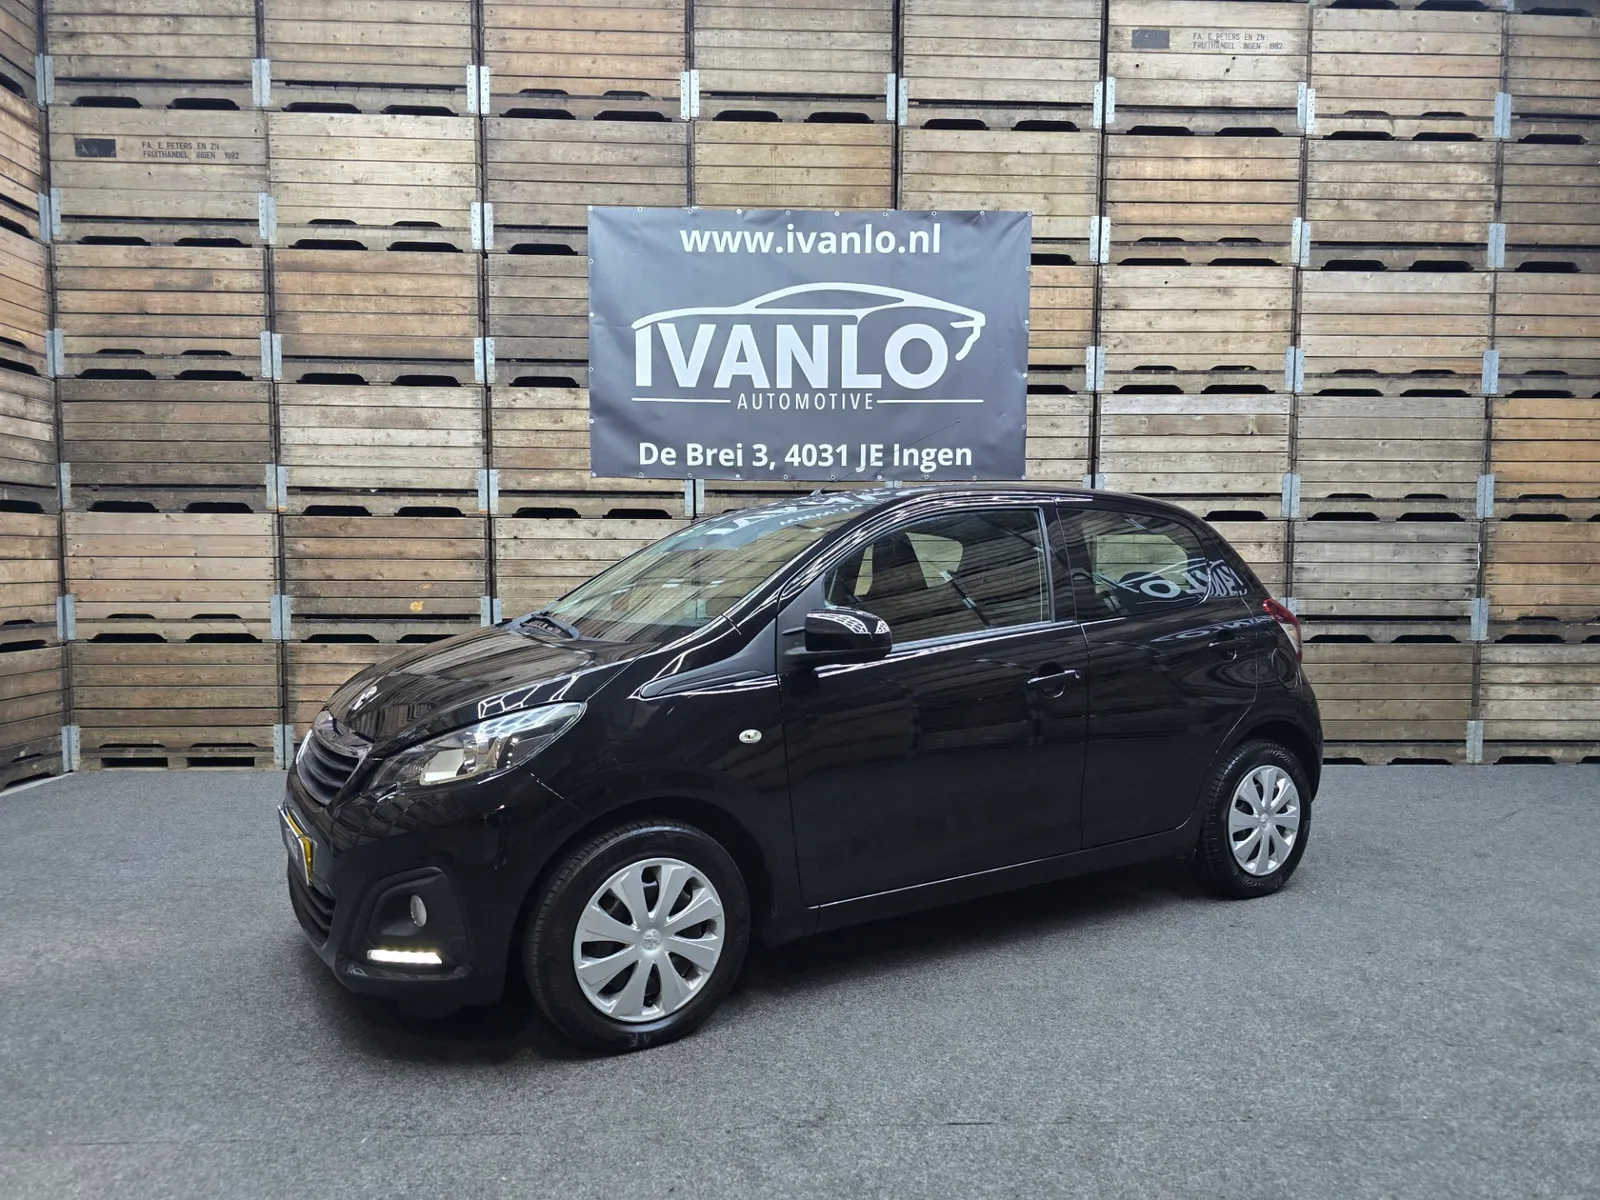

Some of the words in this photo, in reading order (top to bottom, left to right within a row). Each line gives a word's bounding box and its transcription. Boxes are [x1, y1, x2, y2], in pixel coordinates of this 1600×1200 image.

[1216, 33, 1240, 41] PETERS
[1244, 33, 1253, 41] EN
[1242, 42, 1261, 50] INGEN
[167, 142, 193, 150] PETERS
[196, 142, 207, 150] EN
[143, 150, 188, 158] FRUITHANDEL
[195, 151, 216, 159] INGEN
[680, 223, 941, 254] www.ivanlo.nl
[634, 322, 949, 390] IVANLO
[737, 393, 875, 411] AUTOMOTIVE
[639, 442, 677, 466] De
[686, 442, 744, 467] Brei
[752, 444, 776, 471] 3,
[784, 444, 849, 467] 4031
[856, 444, 884, 473] JE
[893, 445, 973, 472] Ingen
